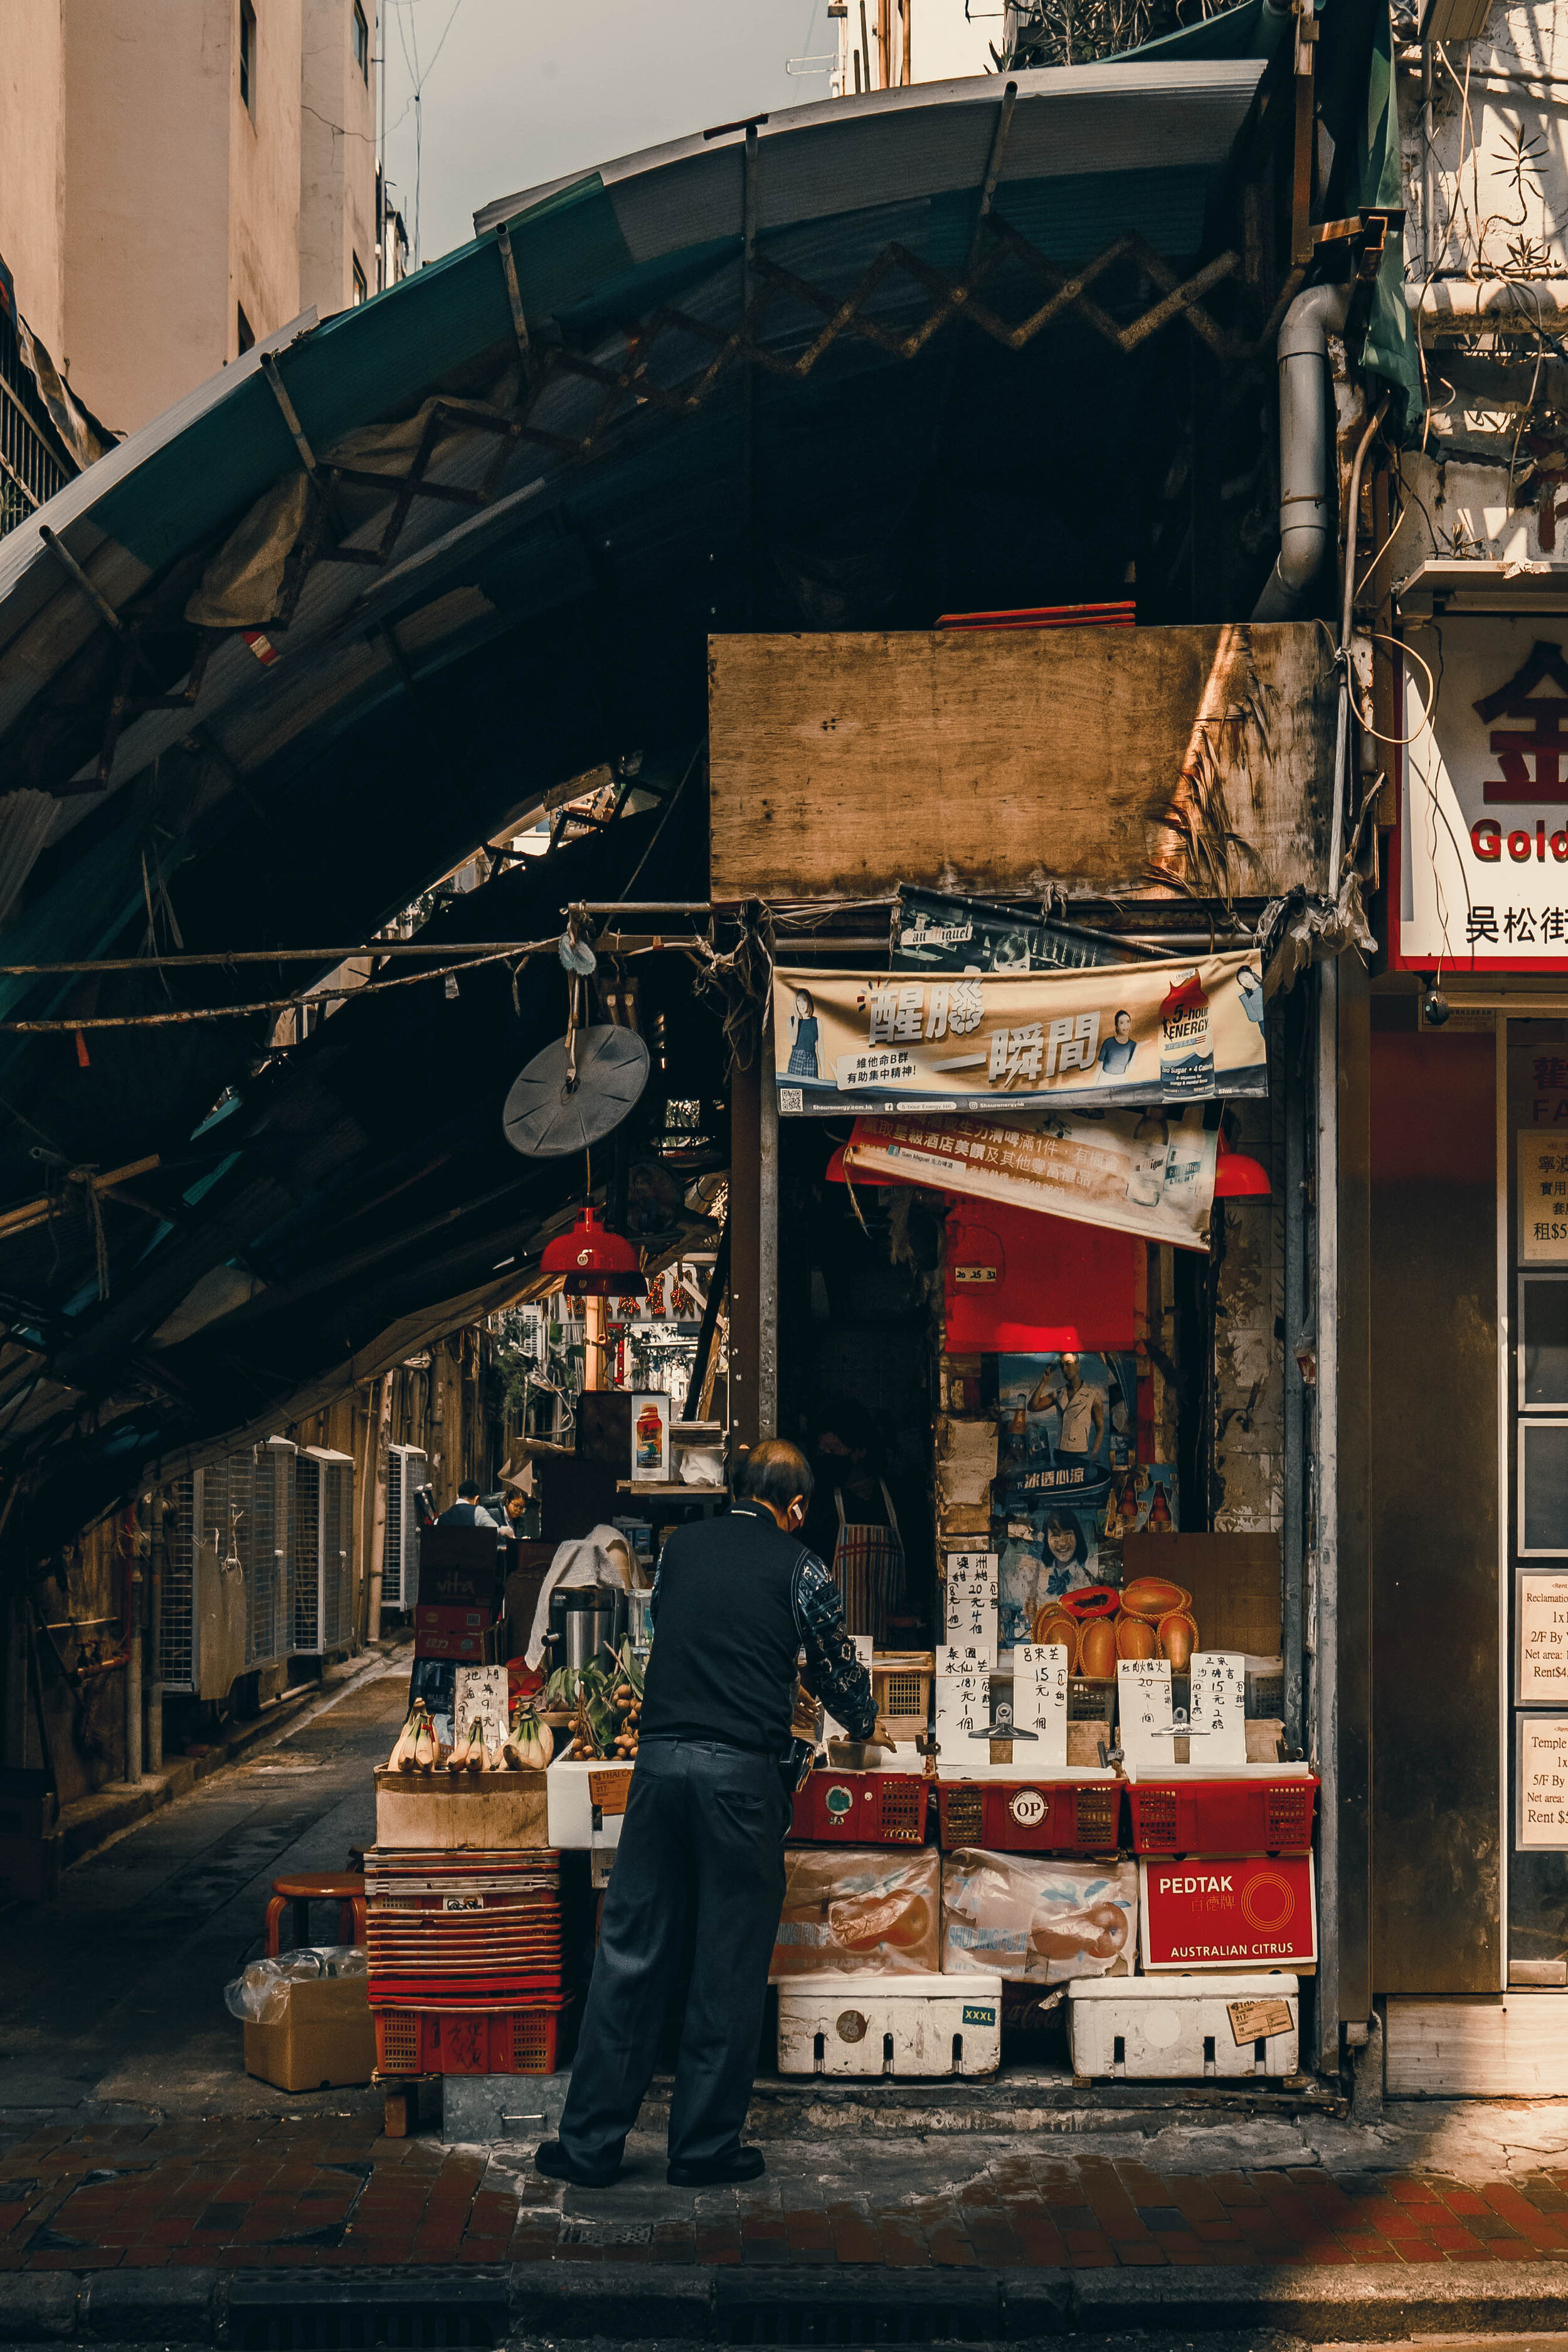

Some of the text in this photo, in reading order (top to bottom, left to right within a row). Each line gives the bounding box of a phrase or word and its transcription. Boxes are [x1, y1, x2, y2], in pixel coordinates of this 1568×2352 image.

[1472, 641, 1568, 803] 金
[931, 925, 969, 941] Miguel
[869, 977, 985, 1046] 醒腦
[1172, 1004, 1209, 1024] 5-hour
[1169, 1018, 1209, 1039] ENERGY
[933, 1011, 1100, 1088] 一瞬間
[857, 1052, 909, 1069] 維他命B群
[1171, 1067, 1187, 1075] Sugar
[812, 1104, 874, 1112] 5hourenergy.com.hk
[921, 1103, 941, 1111] Energy
[913, 1153, 930, 1163] Miguel
[1553, 1202, 1568, 1216] 套
[1531, 1631, 1563, 1645] 2/F By
[1024, 1647, 1059, 1662] 呂宋芒
[1525, 1649, 1562, 1660] Net area:
[1532, 1737, 1567, 1750] Temple
[603, 1771, 620, 1779] THAI
[1533, 1774, 1565, 1788] 5/F By
[1527, 1793, 1564, 1803] Net area:
[1017, 1802, 1041, 1817] OP
[1528, 1809, 1554, 1823] Rent
[1160, 1876, 1233, 1894] PEDTAK
[1192, 1894, 1236, 1912] 百德牌
[1171, 1942, 1293, 1957] AUSTRALIAN CITRUS
[965, 2010, 993, 2022] XXXL
